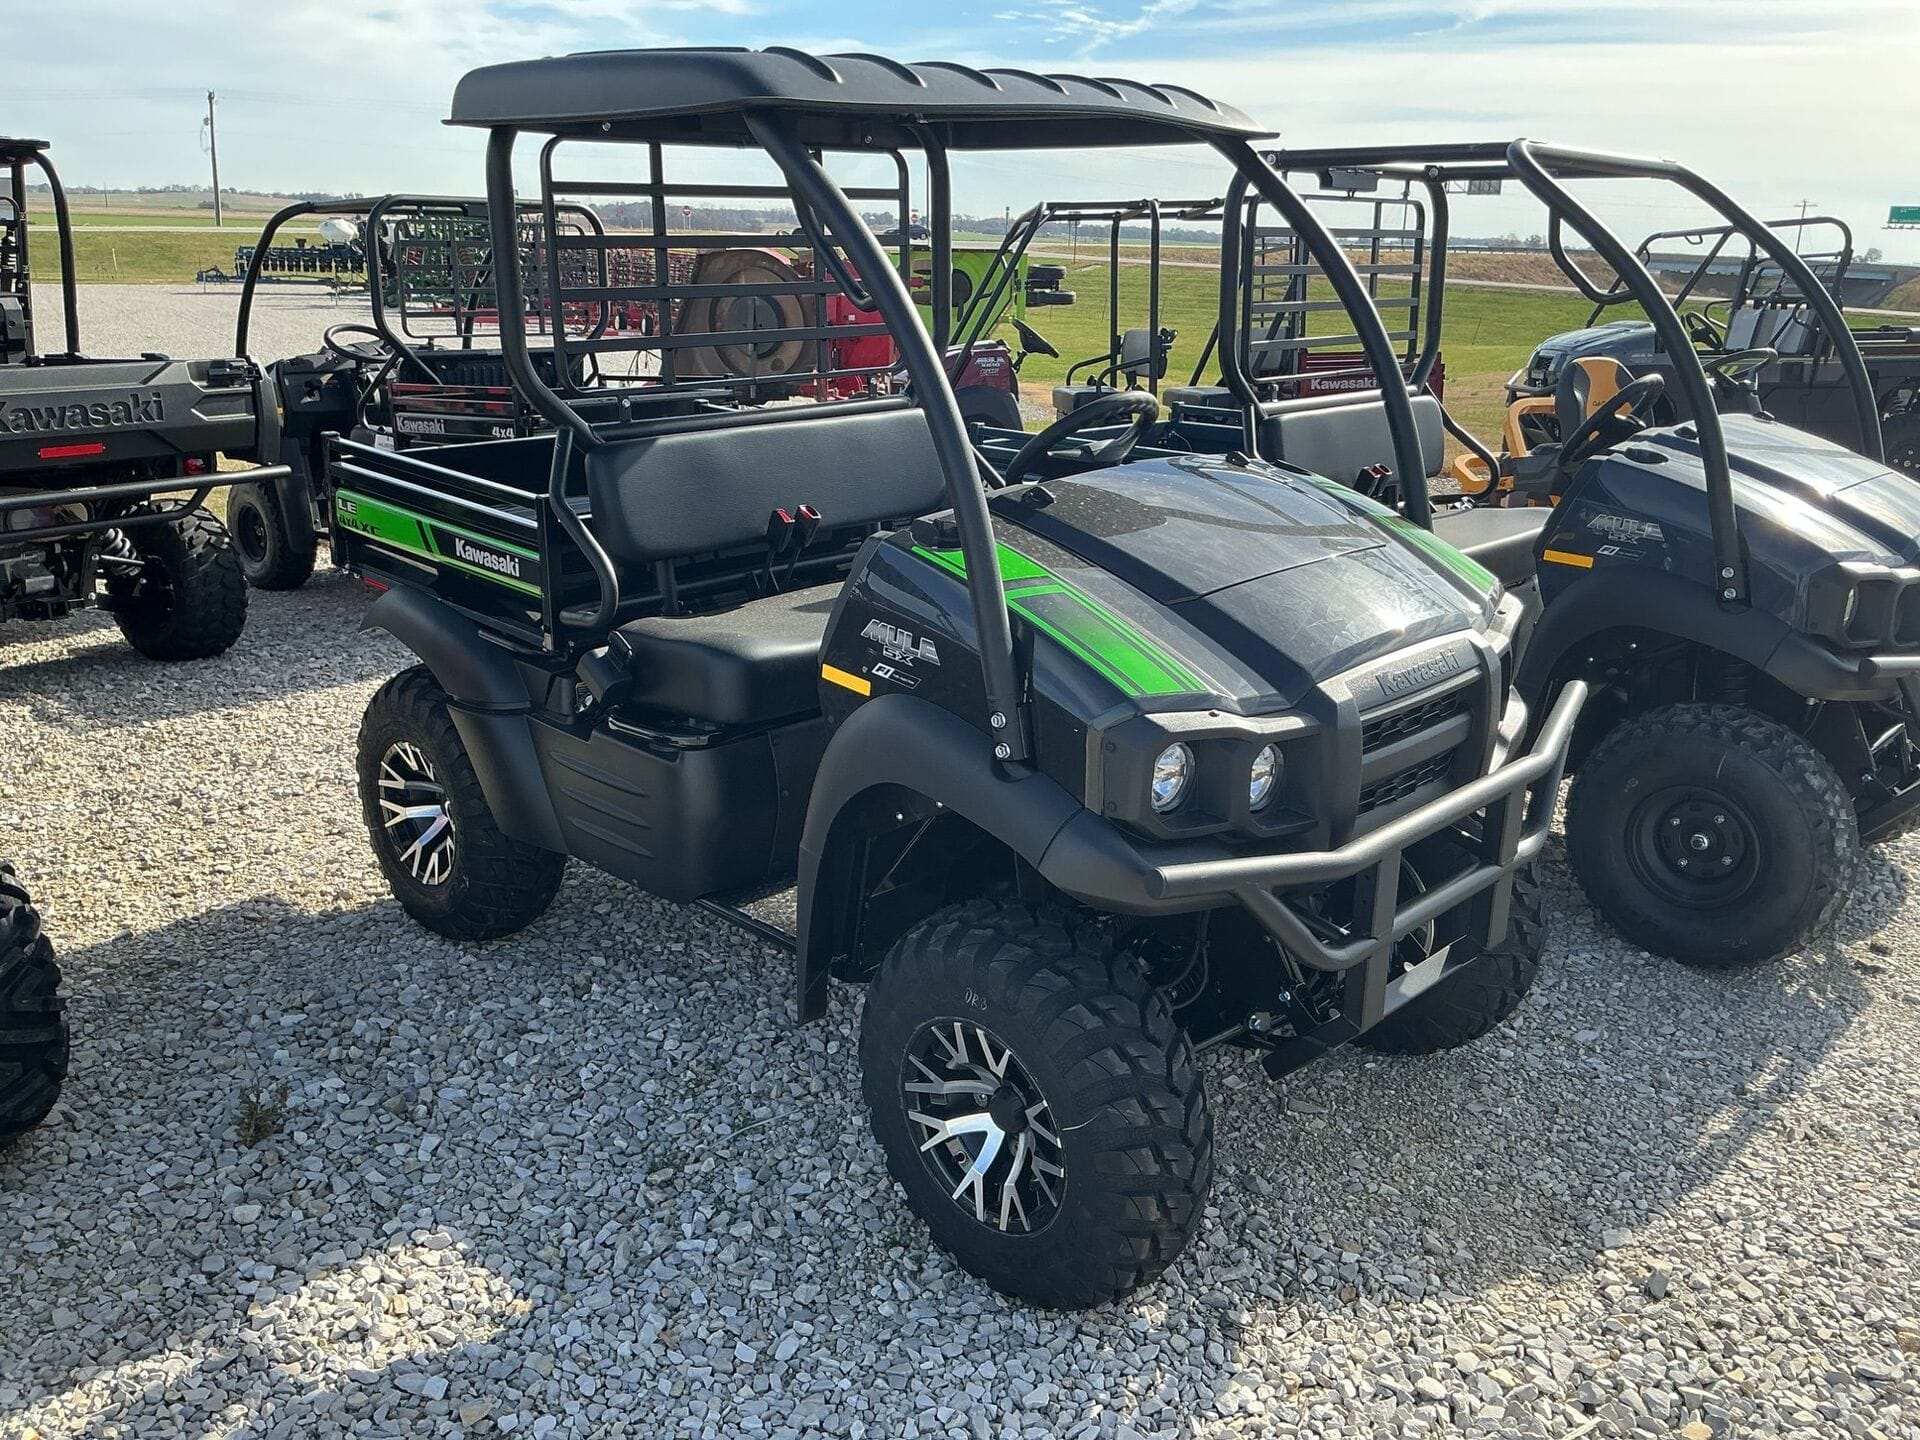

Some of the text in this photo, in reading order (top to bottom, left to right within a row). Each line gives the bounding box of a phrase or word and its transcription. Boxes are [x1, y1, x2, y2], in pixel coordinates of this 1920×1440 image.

[1310, 377, 1377, 390] Kawasaki
[396, 416, 515, 440] Kawasaki 4x4
[337, 497, 358, 514] LE
[1586, 513, 1665, 542] MULE
[454, 537, 521, 577] Kawasaki
[860, 618, 941, 666] MULE
[882, 645, 914, 667] SX
[875, 665, 892, 676] FI
[1374, 646, 1460, 697] Kawasaki
